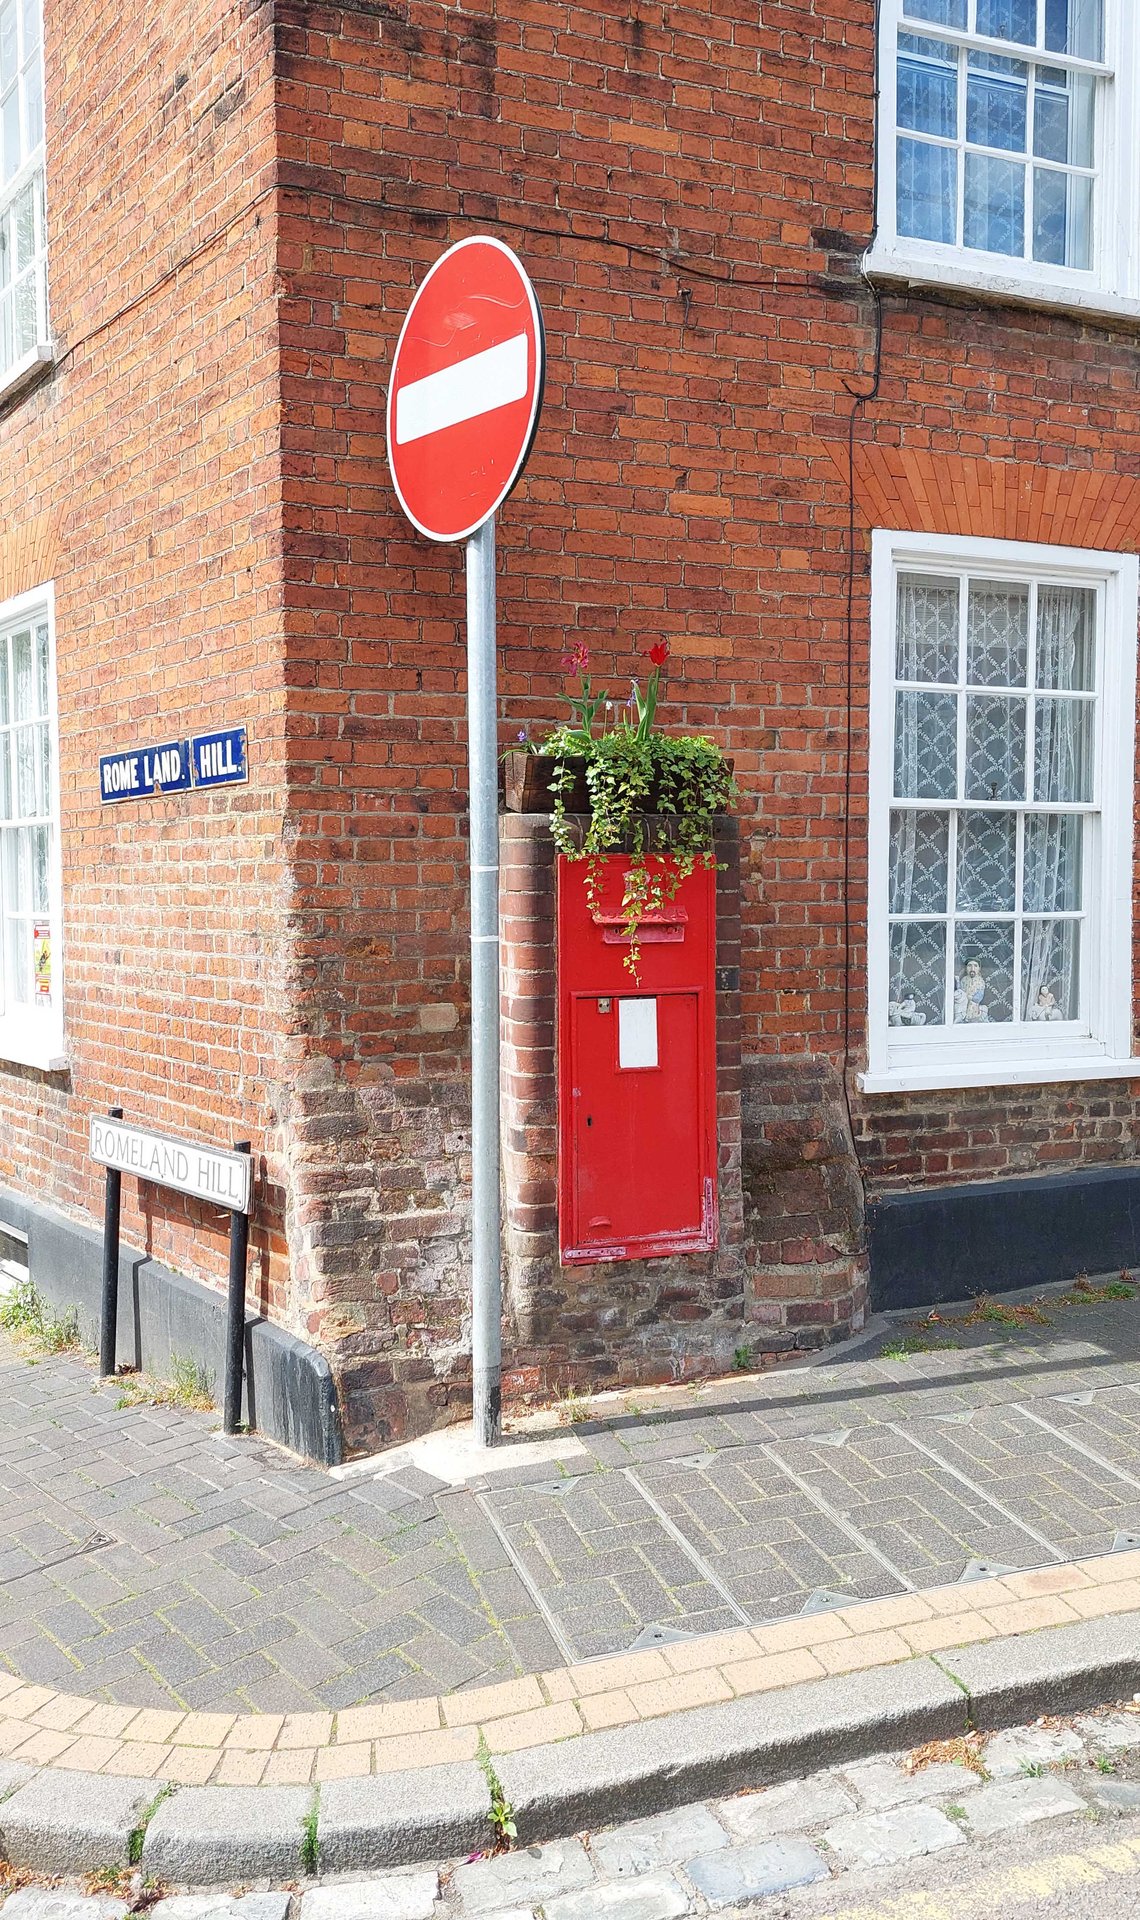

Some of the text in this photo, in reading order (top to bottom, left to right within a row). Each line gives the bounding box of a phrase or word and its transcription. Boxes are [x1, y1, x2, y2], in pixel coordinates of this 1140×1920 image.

[103, 758, 139, 793] ROME
[94, 1127, 239, 1199] ROMELAND HILL
